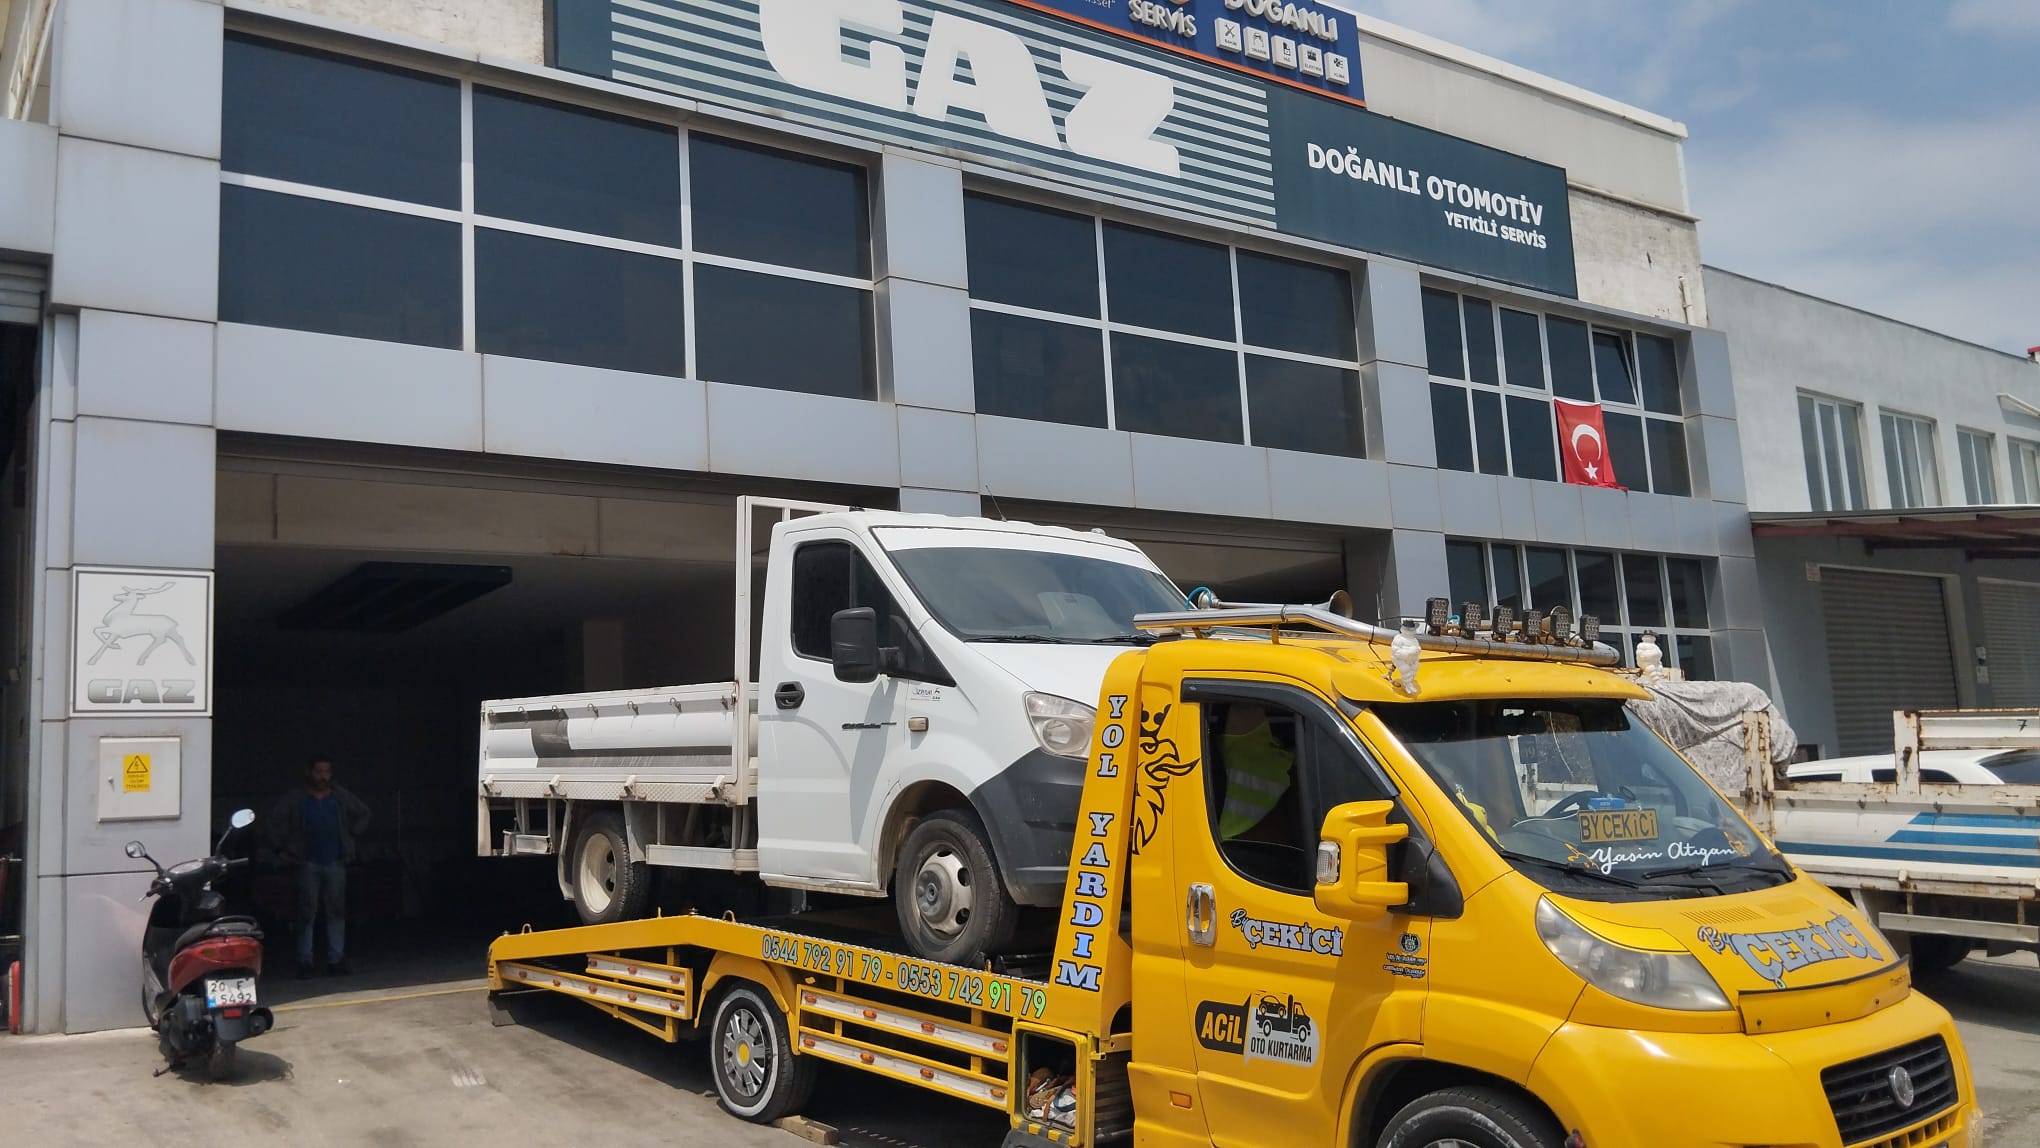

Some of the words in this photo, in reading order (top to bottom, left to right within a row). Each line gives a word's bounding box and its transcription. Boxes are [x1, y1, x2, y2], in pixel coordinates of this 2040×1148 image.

[759, 0, 1180, 178] GAZ
[1306, 142, 1420, 195] DOĞANLI
[1427, 175, 1543, 226] OTOMOTİV
[1444, 210, 1498, 237] YETKİLİ
[1500, 225, 1547, 249] SERVİS
[87, 678, 195, 704] GAZ
[1097, 695, 1128, 777] YOL
[1580, 815, 1600, 840] BY
[1590, 846, 1662, 875] Yasin
[1055, 812, 1114, 992] YARDIM
[210, 982, 226, 993] 20
[761, 934, 798, 963] 0544
[803, 943, 831, 971] 792
[835, 949, 854, 977] 91
[861, 954, 883, 982] 79
[897, 963, 942, 996] 0553
[948, 973, 983, 1006] 742
[989, 981, 1011, 1012] 91
[1021, 987, 1047, 1019] 79
[220, 993, 252, 1005] 5492
[1250, 1036, 1266, 1055] OTO
[1267, 1040, 1312, 1063] KURTARMA
